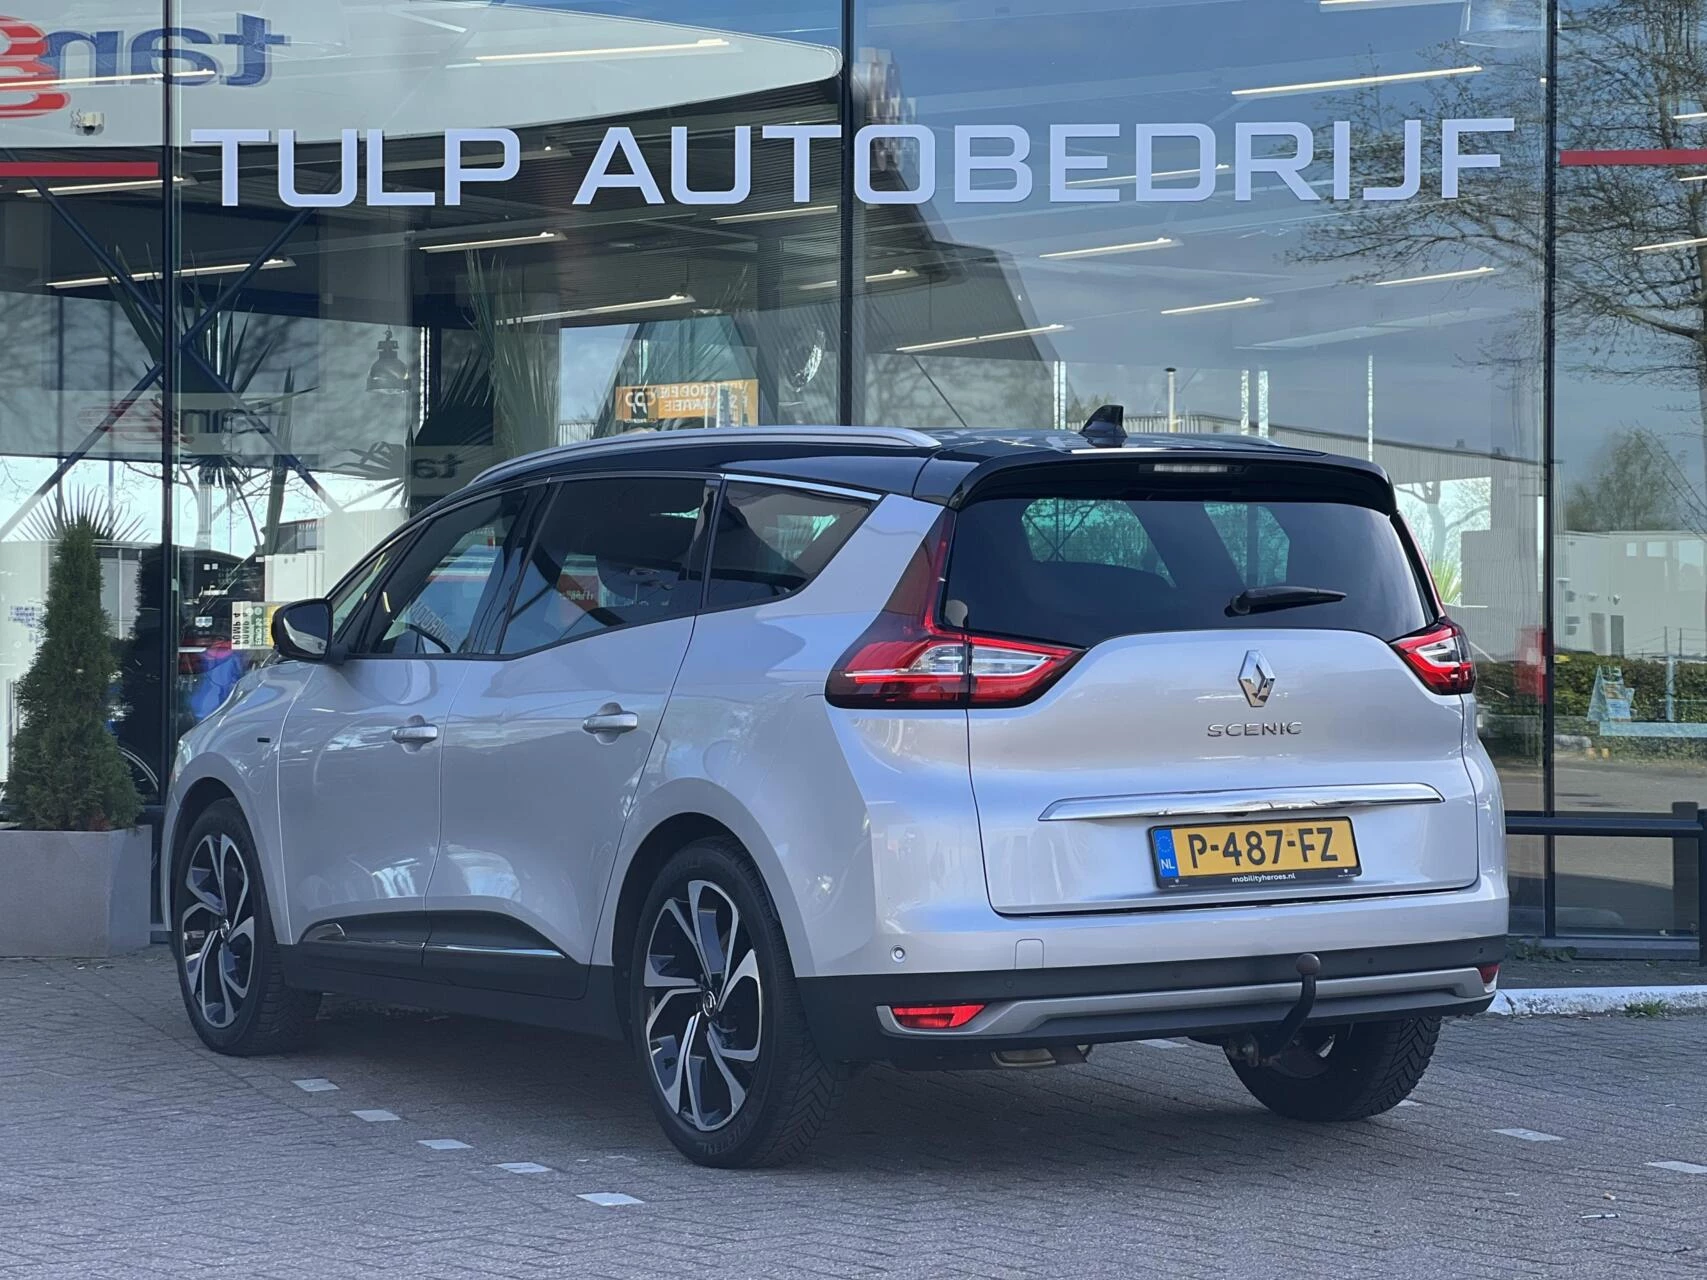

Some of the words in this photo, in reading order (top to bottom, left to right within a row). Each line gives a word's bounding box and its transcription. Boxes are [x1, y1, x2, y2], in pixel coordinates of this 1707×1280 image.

[191, 128, 521, 207] TULP
[572, 118, 1515, 206] AUTOBEDRIJF
[1207, 721, 1302, 737] SCENIC
[1160, 858, 1176, 870] NL
[1187, 827, 1338, 869] P-487-FZ
[1231, 873, 1296, 883] mobilityheroes.nl
